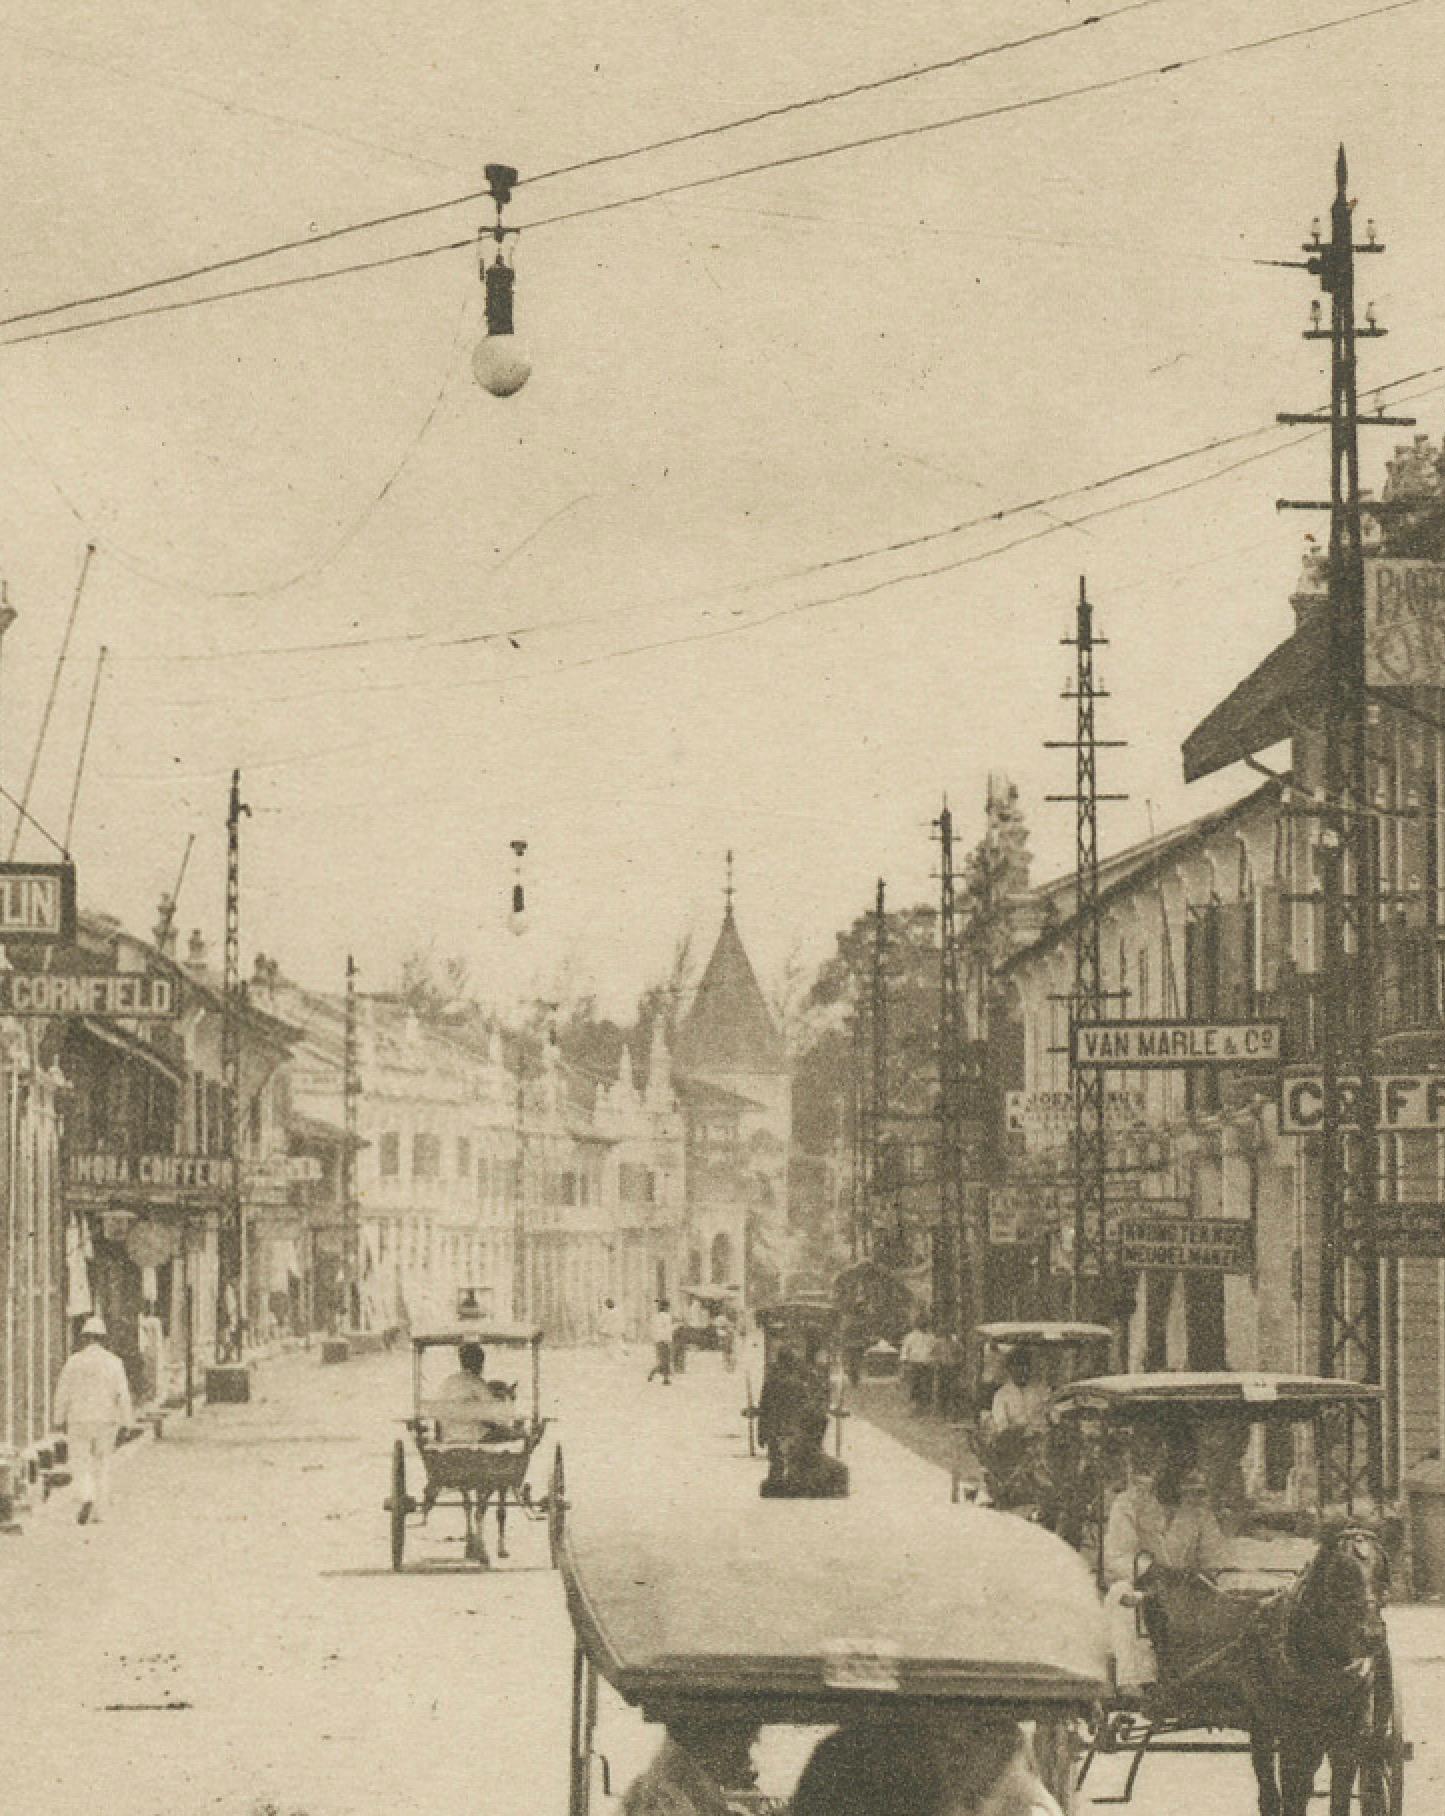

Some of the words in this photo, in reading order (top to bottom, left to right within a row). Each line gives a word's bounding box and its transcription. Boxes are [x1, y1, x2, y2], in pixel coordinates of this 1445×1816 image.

[12, 977, 172, 1013] CORNFIELD
[1084, 1031, 1129, 1057] VAN
[1137, 1029, 1217, 1057] MARLE
[1224, 1037, 1237, 1055] &
